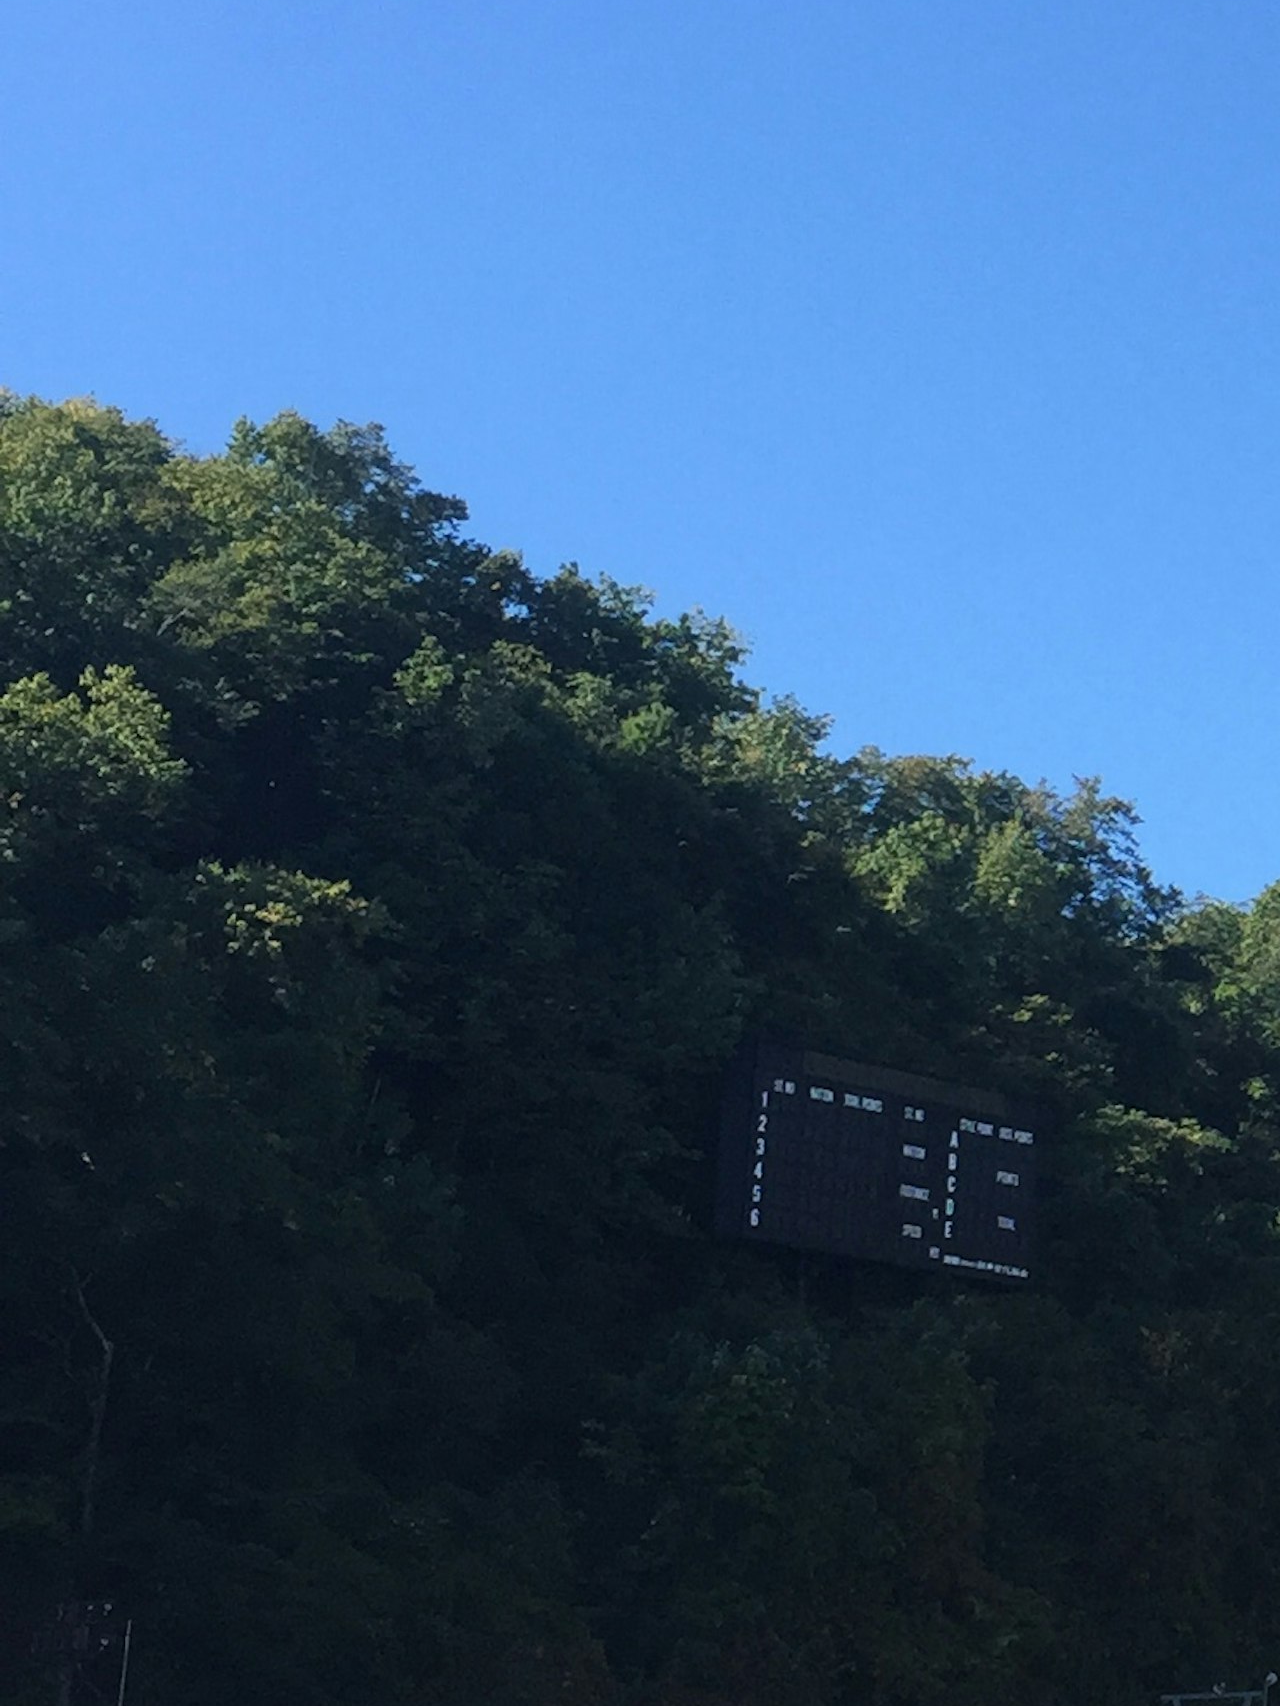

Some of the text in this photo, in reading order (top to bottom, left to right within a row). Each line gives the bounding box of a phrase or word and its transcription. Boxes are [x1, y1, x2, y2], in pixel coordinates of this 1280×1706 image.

[757, 1115, 768, 1132] 2
[757, 1138, 765, 1155] 3
[949, 1130, 959, 1148] A
[753, 1162, 763, 1179] 4
[947, 1175, 956, 1193] C
[752, 1185, 761, 1203] 5
[945, 1198, 955, 1216] D
[750, 1209, 759, 1226] 6
[944, 1220, 953, 1239] E
